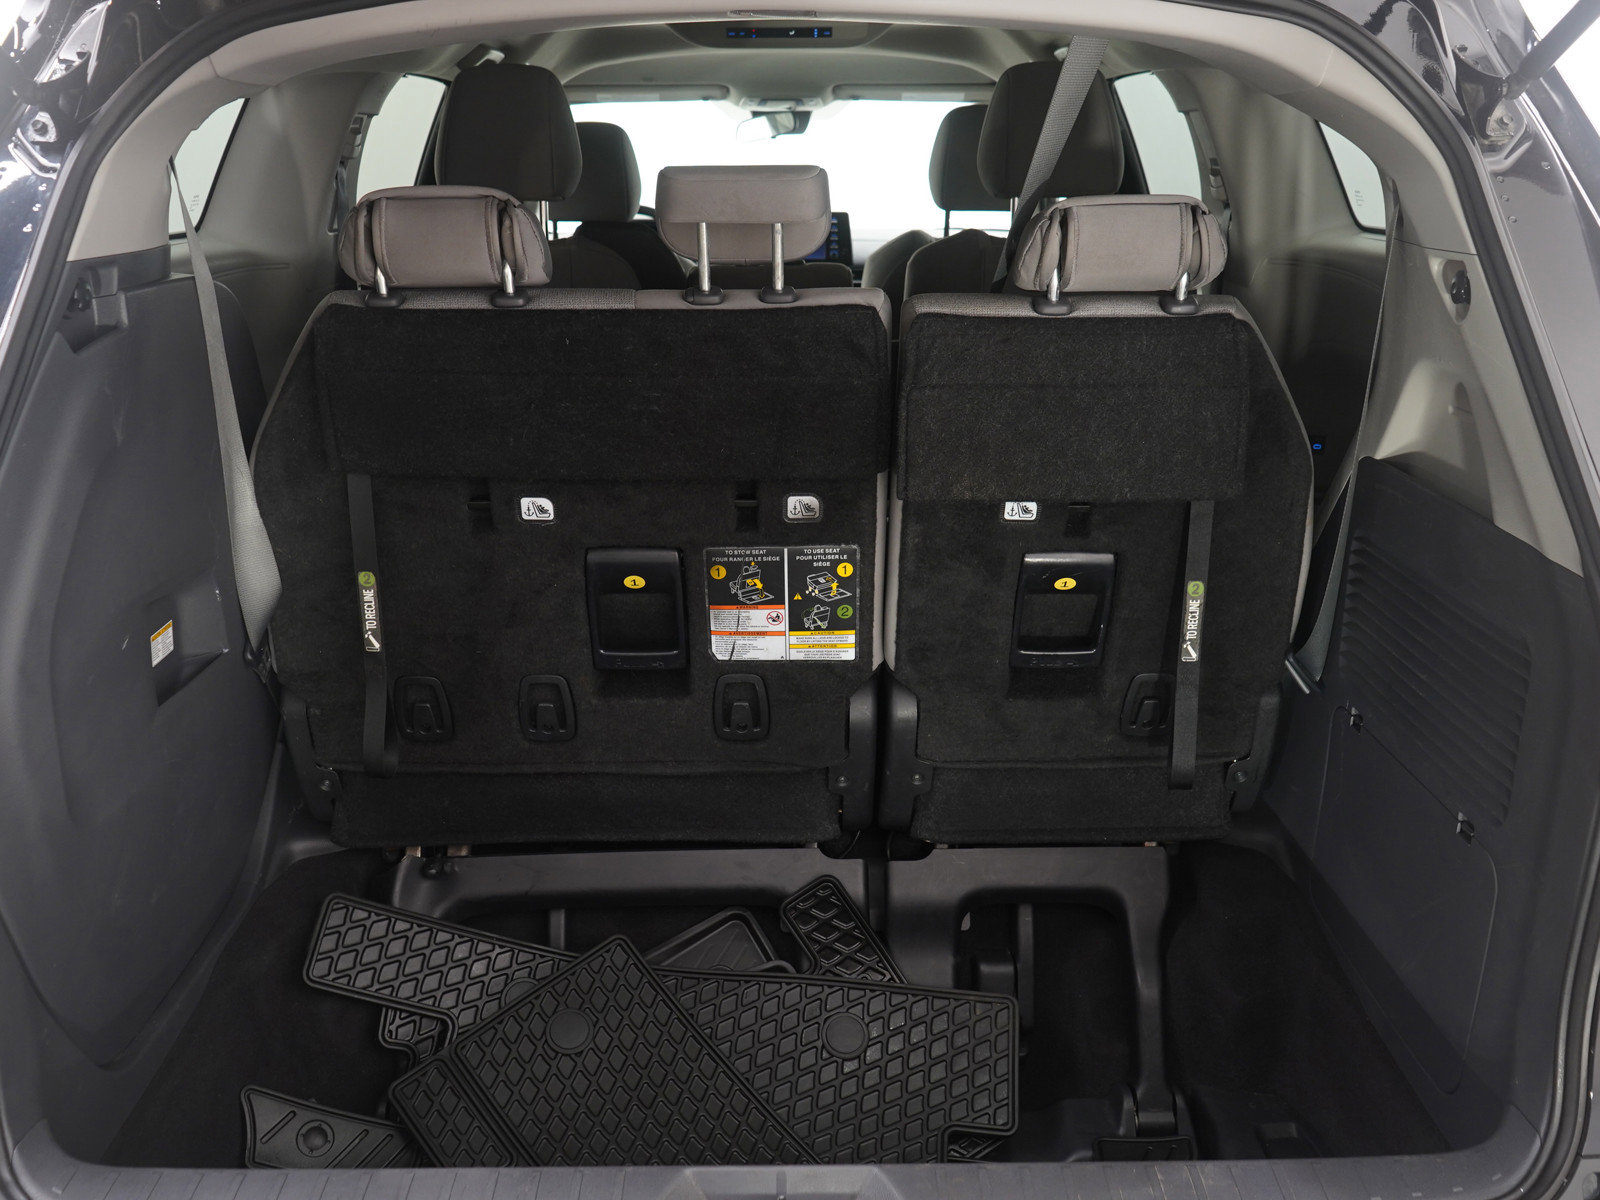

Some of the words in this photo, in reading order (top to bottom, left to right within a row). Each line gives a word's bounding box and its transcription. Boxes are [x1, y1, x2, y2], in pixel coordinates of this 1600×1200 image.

[363, 573, 371, 584] 2
[1191, 583, 1200, 595] 2
[363, 589, 376, 619] RECLINE
[841, 606, 849, 617] 2
[1187, 599, 1200, 629] RECLINE
[365, 620, 377, 630] TO
[1186, 630, 1198, 640] TO
